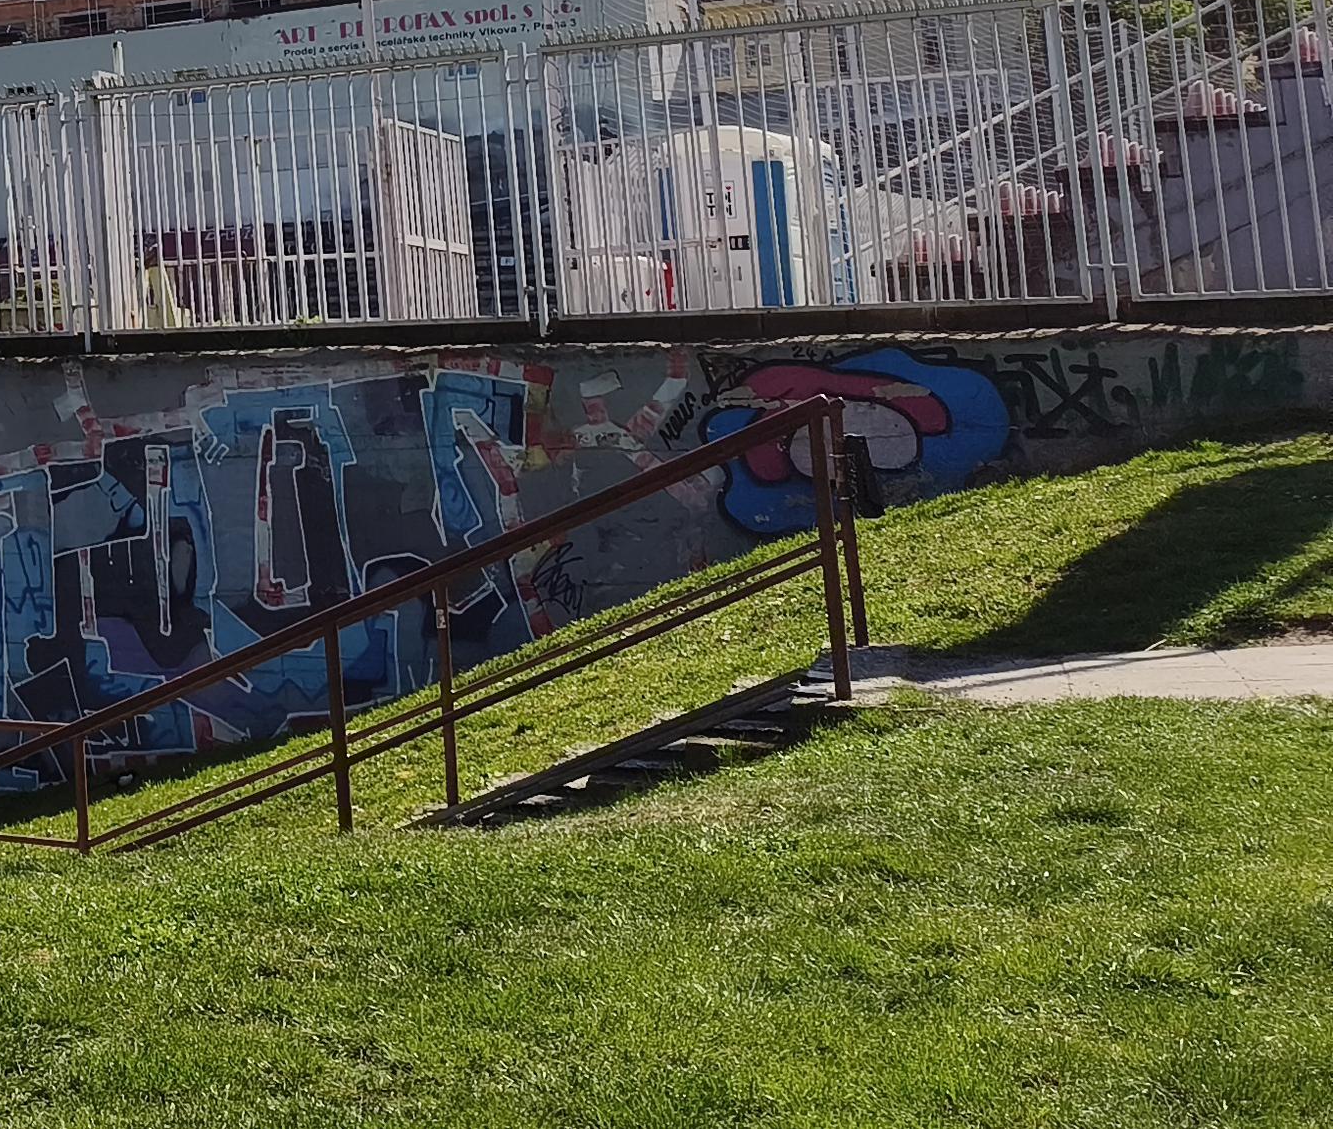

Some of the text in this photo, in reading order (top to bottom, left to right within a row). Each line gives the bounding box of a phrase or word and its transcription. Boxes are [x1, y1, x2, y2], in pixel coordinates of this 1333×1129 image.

[275, 24, 318, 45] ART
[464, 4, 516, 24] spol.
[523, 3, 533, 18] s
[284, 46, 316, 57] Prodej
[328, 42, 359, 52] servis
[429, 29, 475, 42] techniky
[479, 25, 516, 36] Vlkova
[520, 23, 530, 32] 7,
[534, 20, 567, 31] Prha
[570, 18, 577, 27] 3
